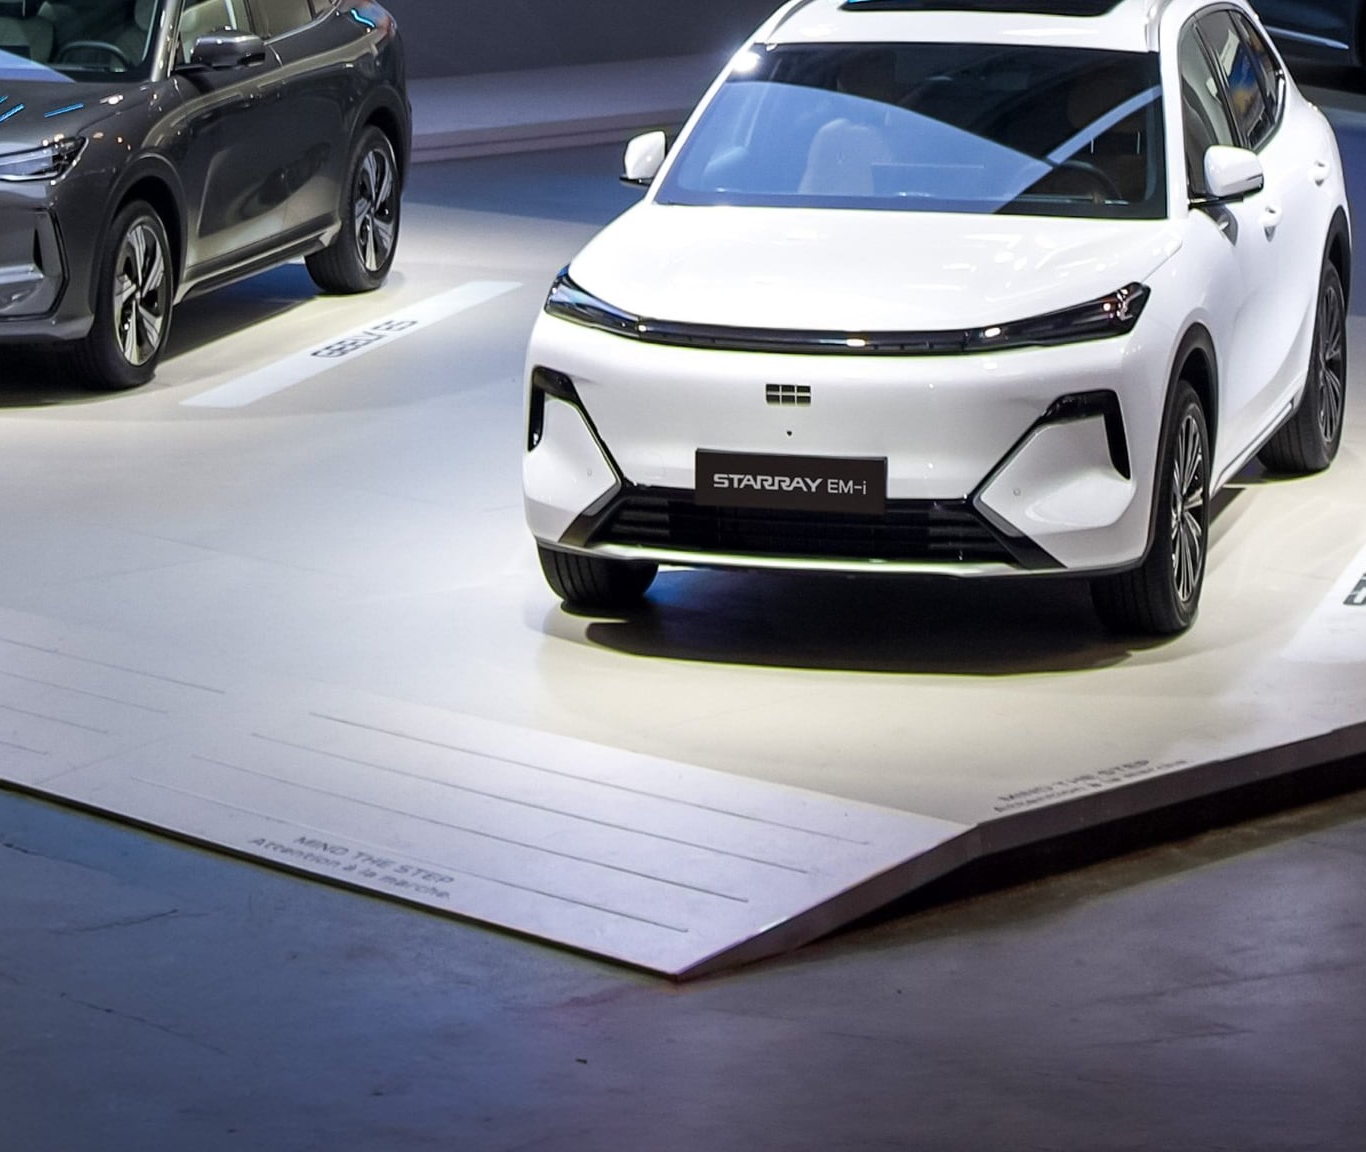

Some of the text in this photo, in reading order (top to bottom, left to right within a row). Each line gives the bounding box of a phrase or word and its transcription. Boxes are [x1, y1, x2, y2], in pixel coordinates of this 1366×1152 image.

[310, 331, 386, 357] GEELY
[713, 473, 867, 495] STARRAY EM-i
[247, 837, 342, 867] Attention
[360, 867, 378, 879] la
[379, 874, 450, 898] marche
[293, 835, 455, 884] MIND THE STEP
